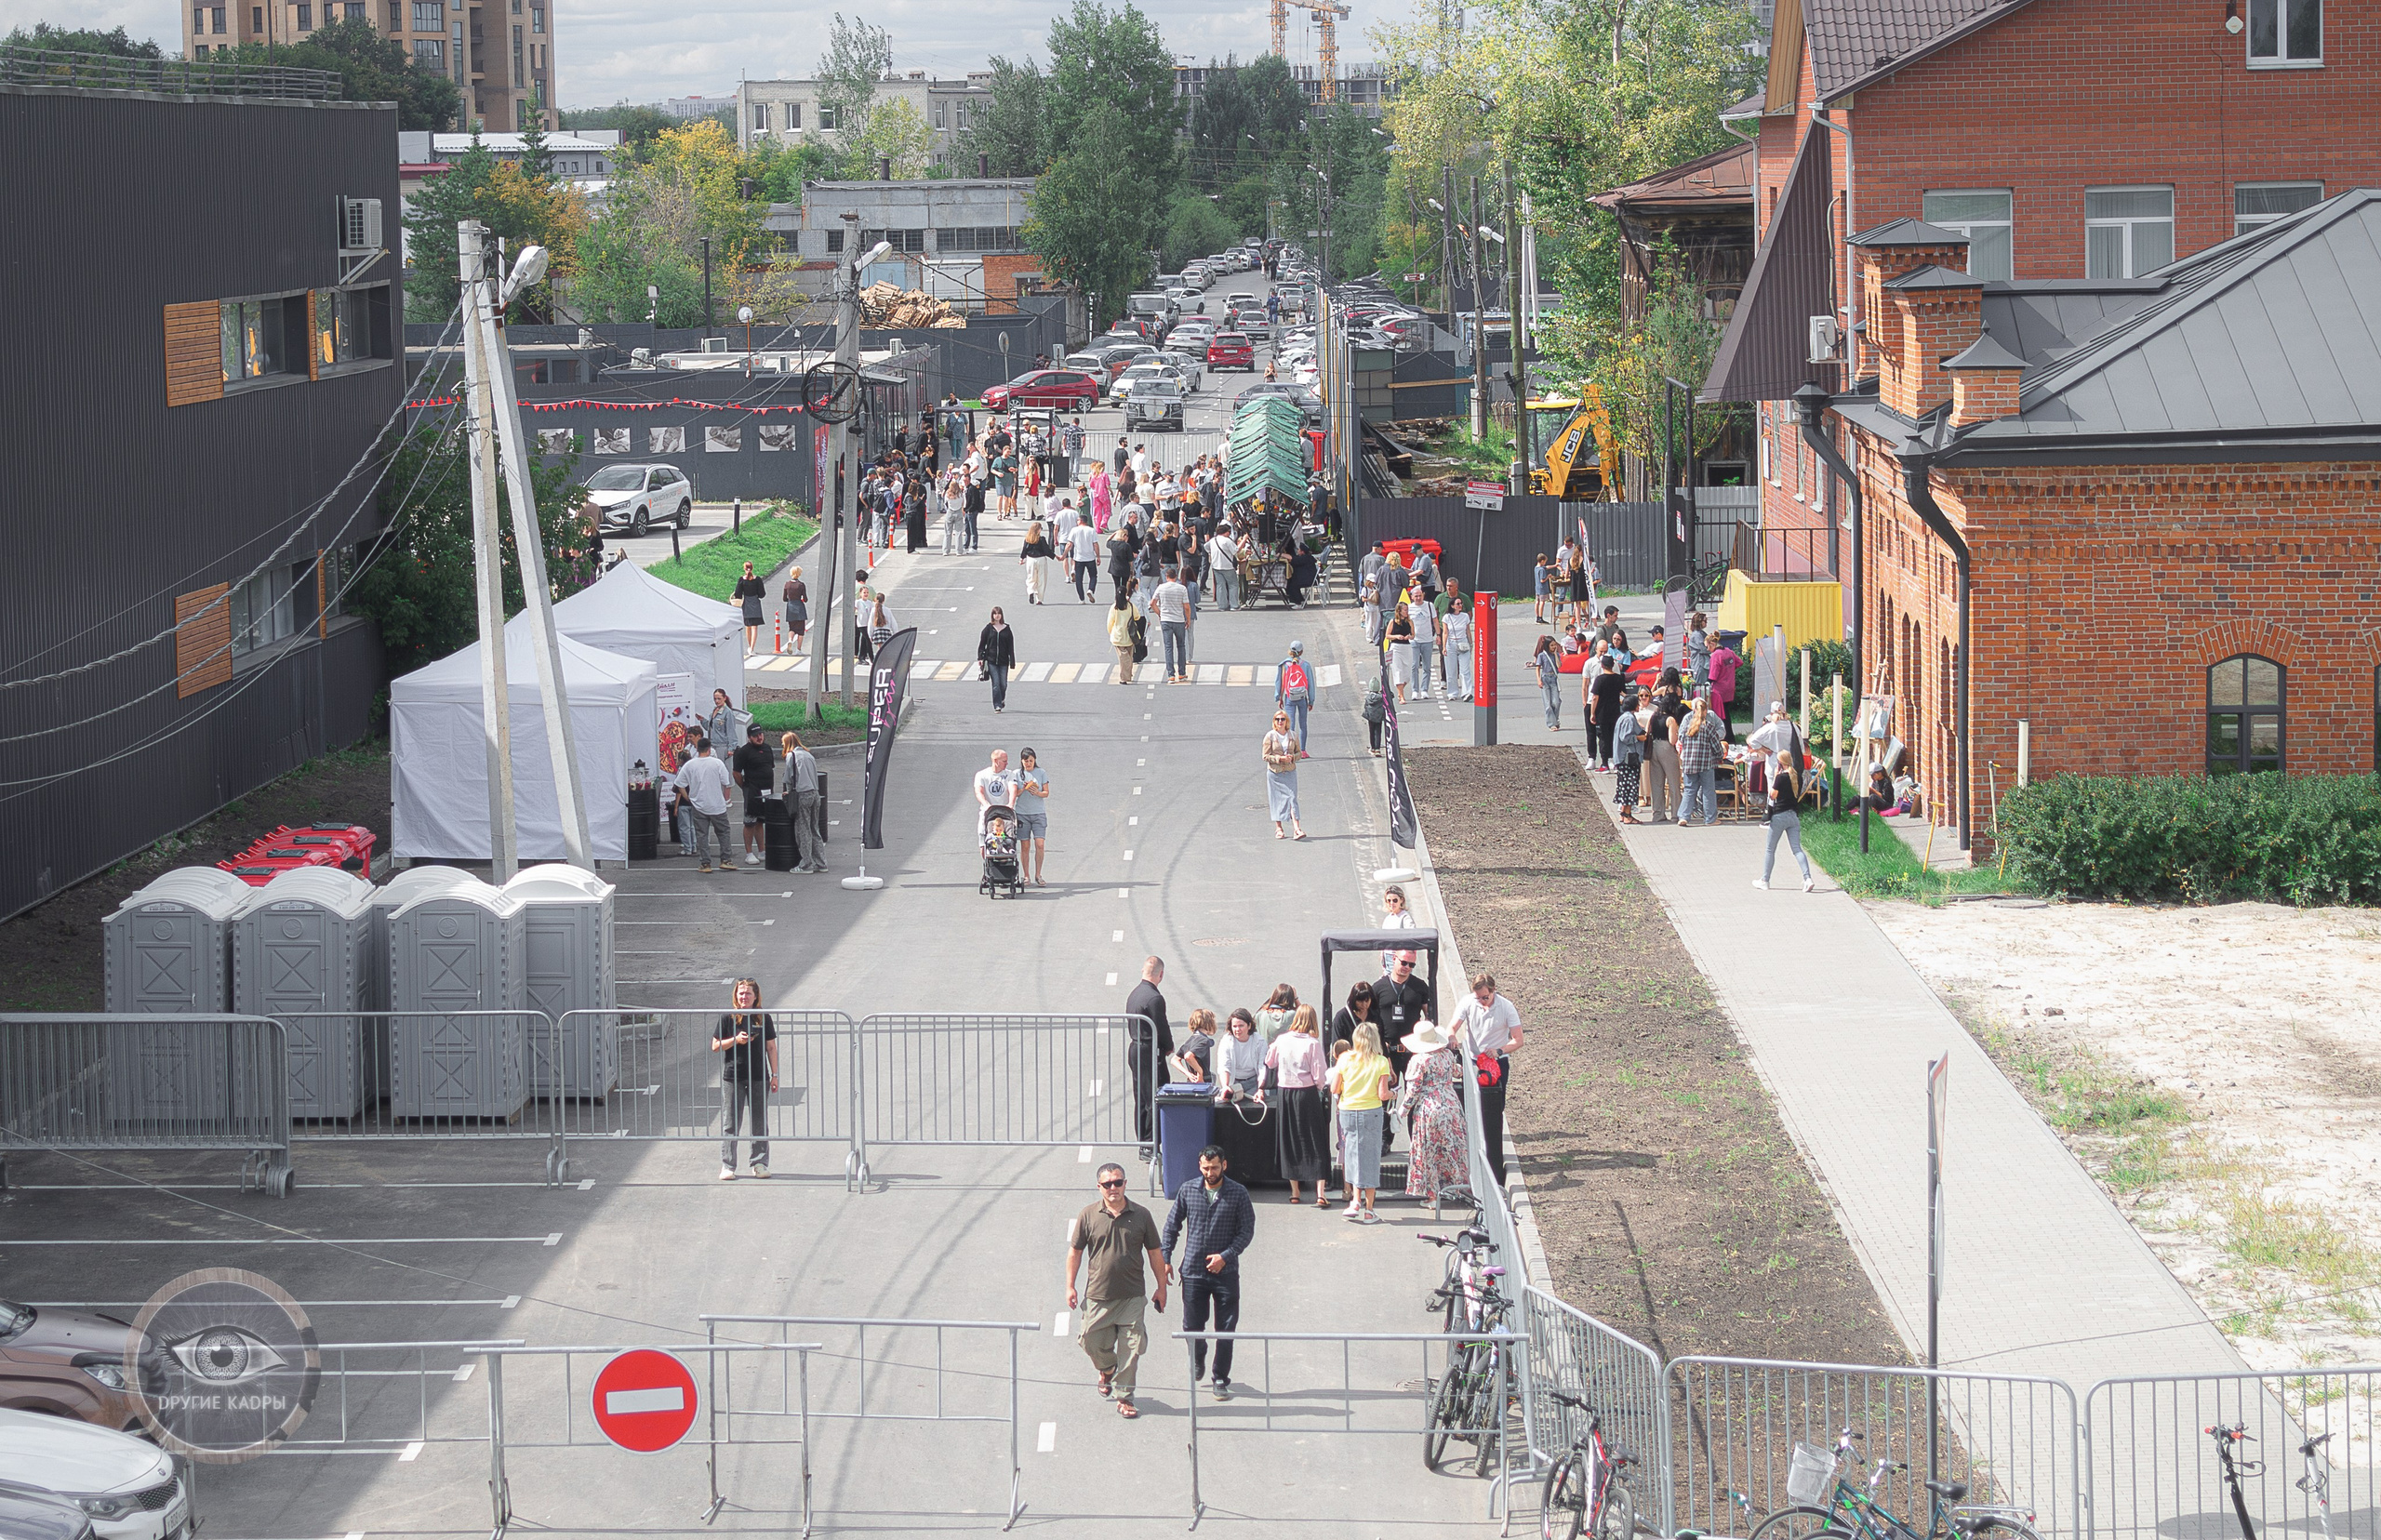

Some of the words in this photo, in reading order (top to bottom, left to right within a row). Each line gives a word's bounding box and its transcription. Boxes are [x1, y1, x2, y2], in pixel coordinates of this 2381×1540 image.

[1563, 430, 1581, 462] JCB
[1472, 482, 1499, 490] ВНИМАНИЕ
[991, 785, 1002, 793] LV
